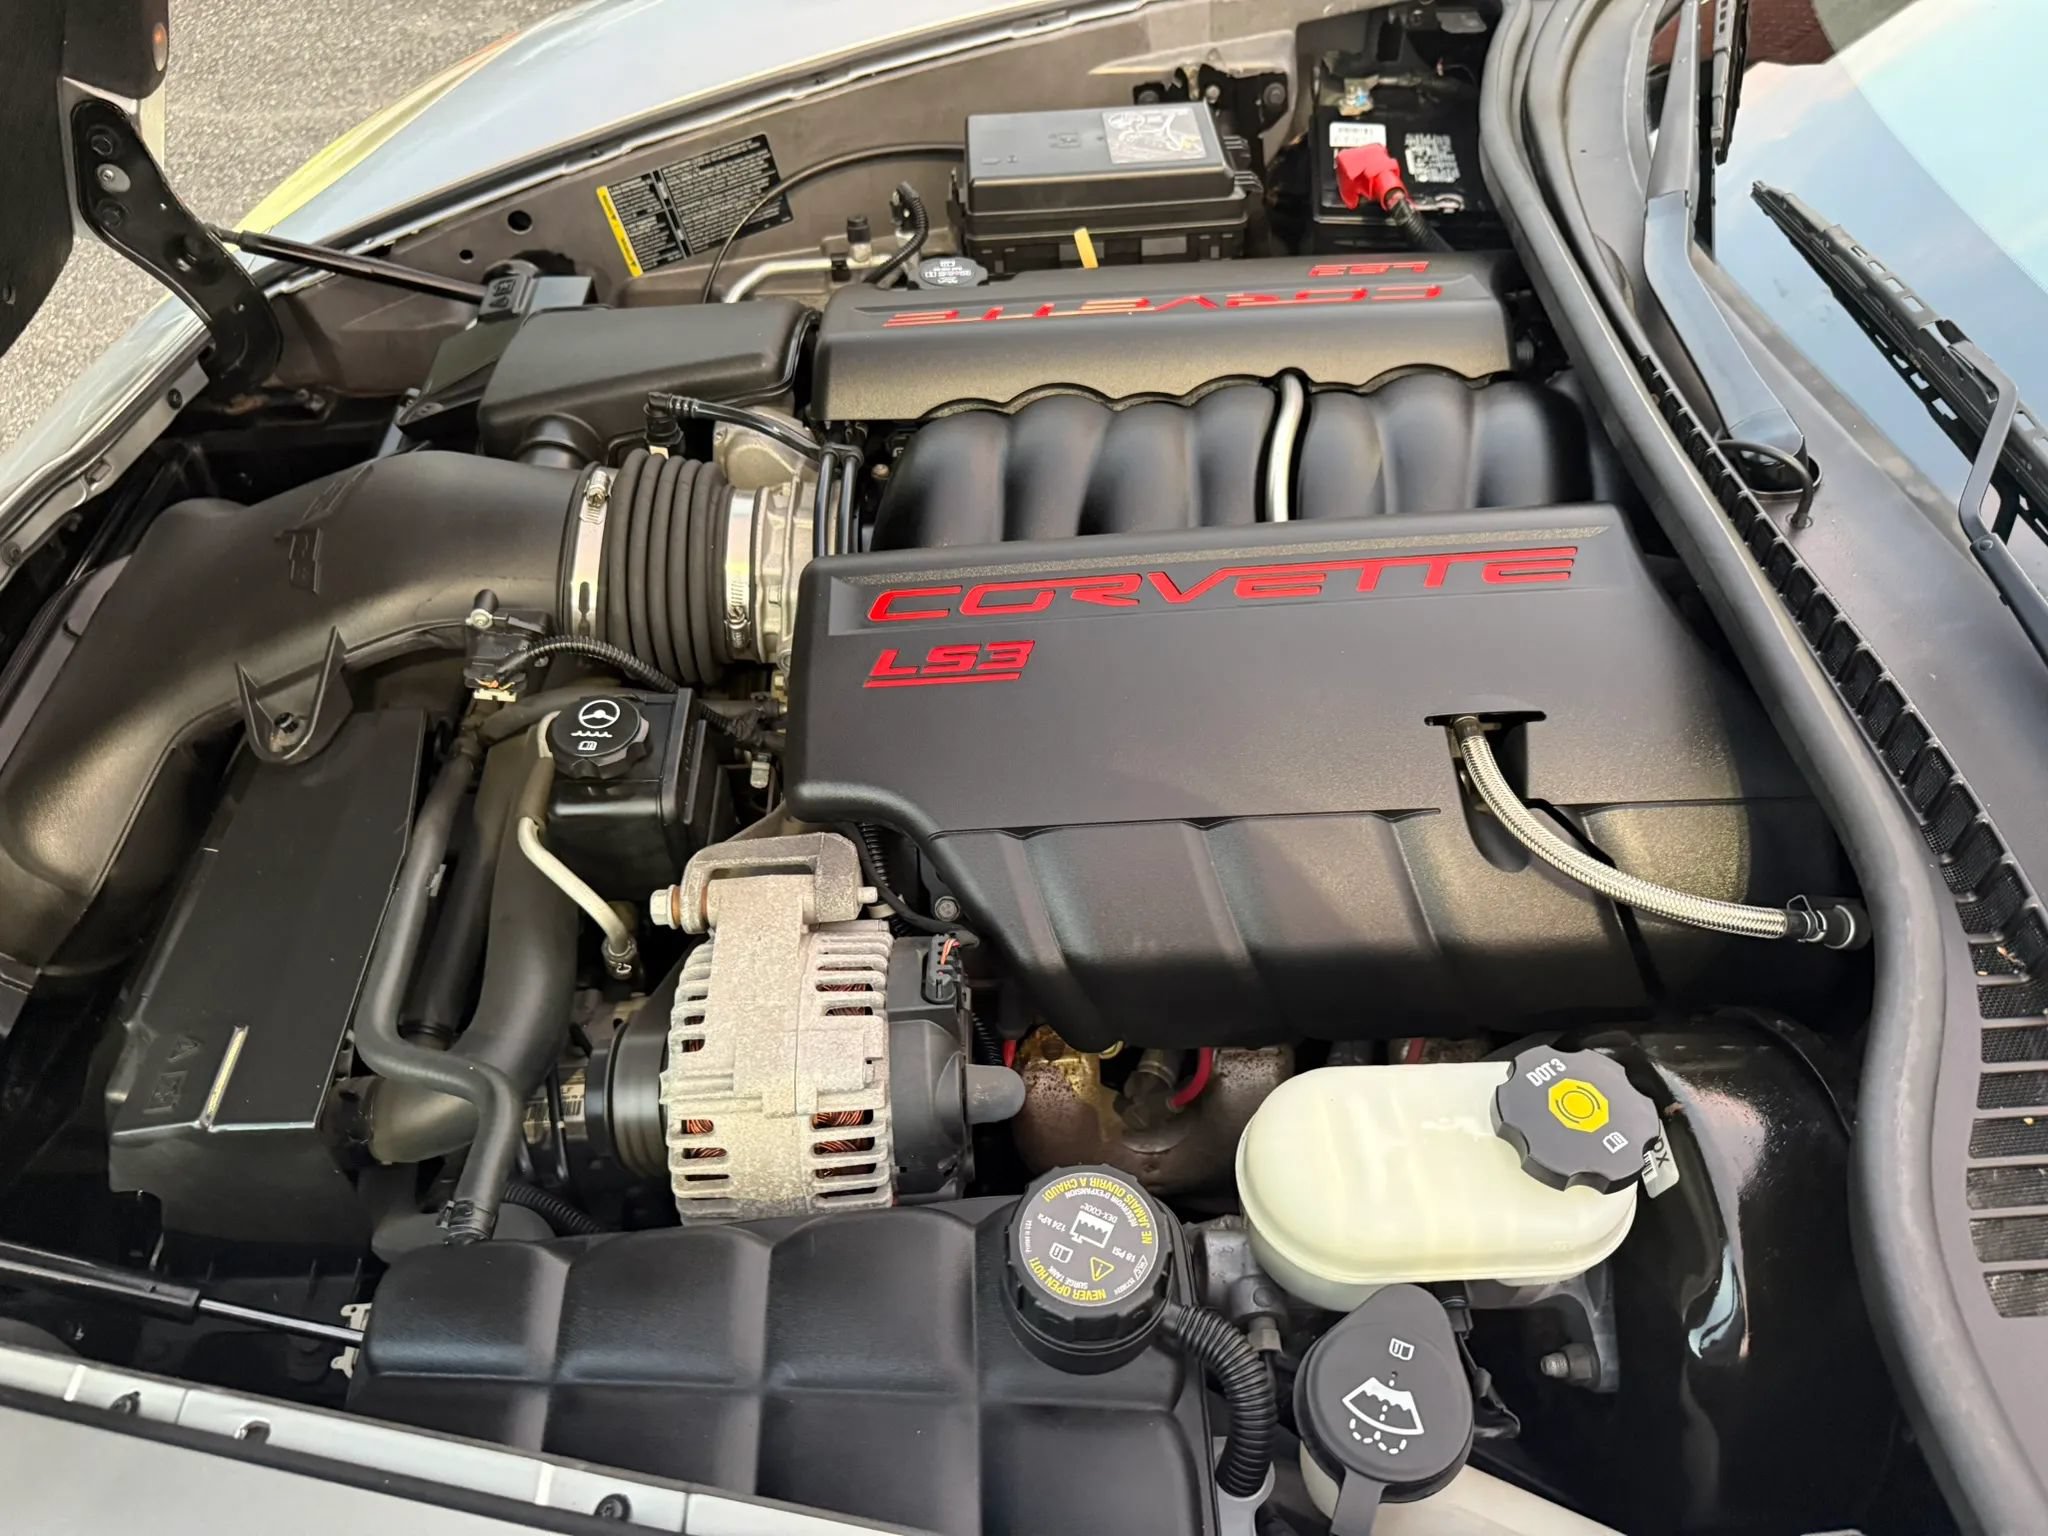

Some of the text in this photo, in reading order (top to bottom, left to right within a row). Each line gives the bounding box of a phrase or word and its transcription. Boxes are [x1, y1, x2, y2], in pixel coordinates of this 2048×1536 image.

[884, 284, 1443, 327] CORVETTE
[868, 547, 1578, 622] CORVETTE
[862, 639, 1035, 685] LS3
[1042, 1177, 1078, 1202] CHAUD!
[1090, 1177, 1126, 1198] OUVRIR
[1037, 1212, 1066, 1233] 124 kPa
[1123, 1194, 1150, 1228] JAMAIS
[1141, 1230, 1152, 1244] NE
[1111, 1246, 1136, 1263] 18 PSI
[1028, 1257, 1107, 1301] NEVER OPEN HOT!
[1046, 1264, 1088, 1289] SURGE TANK
